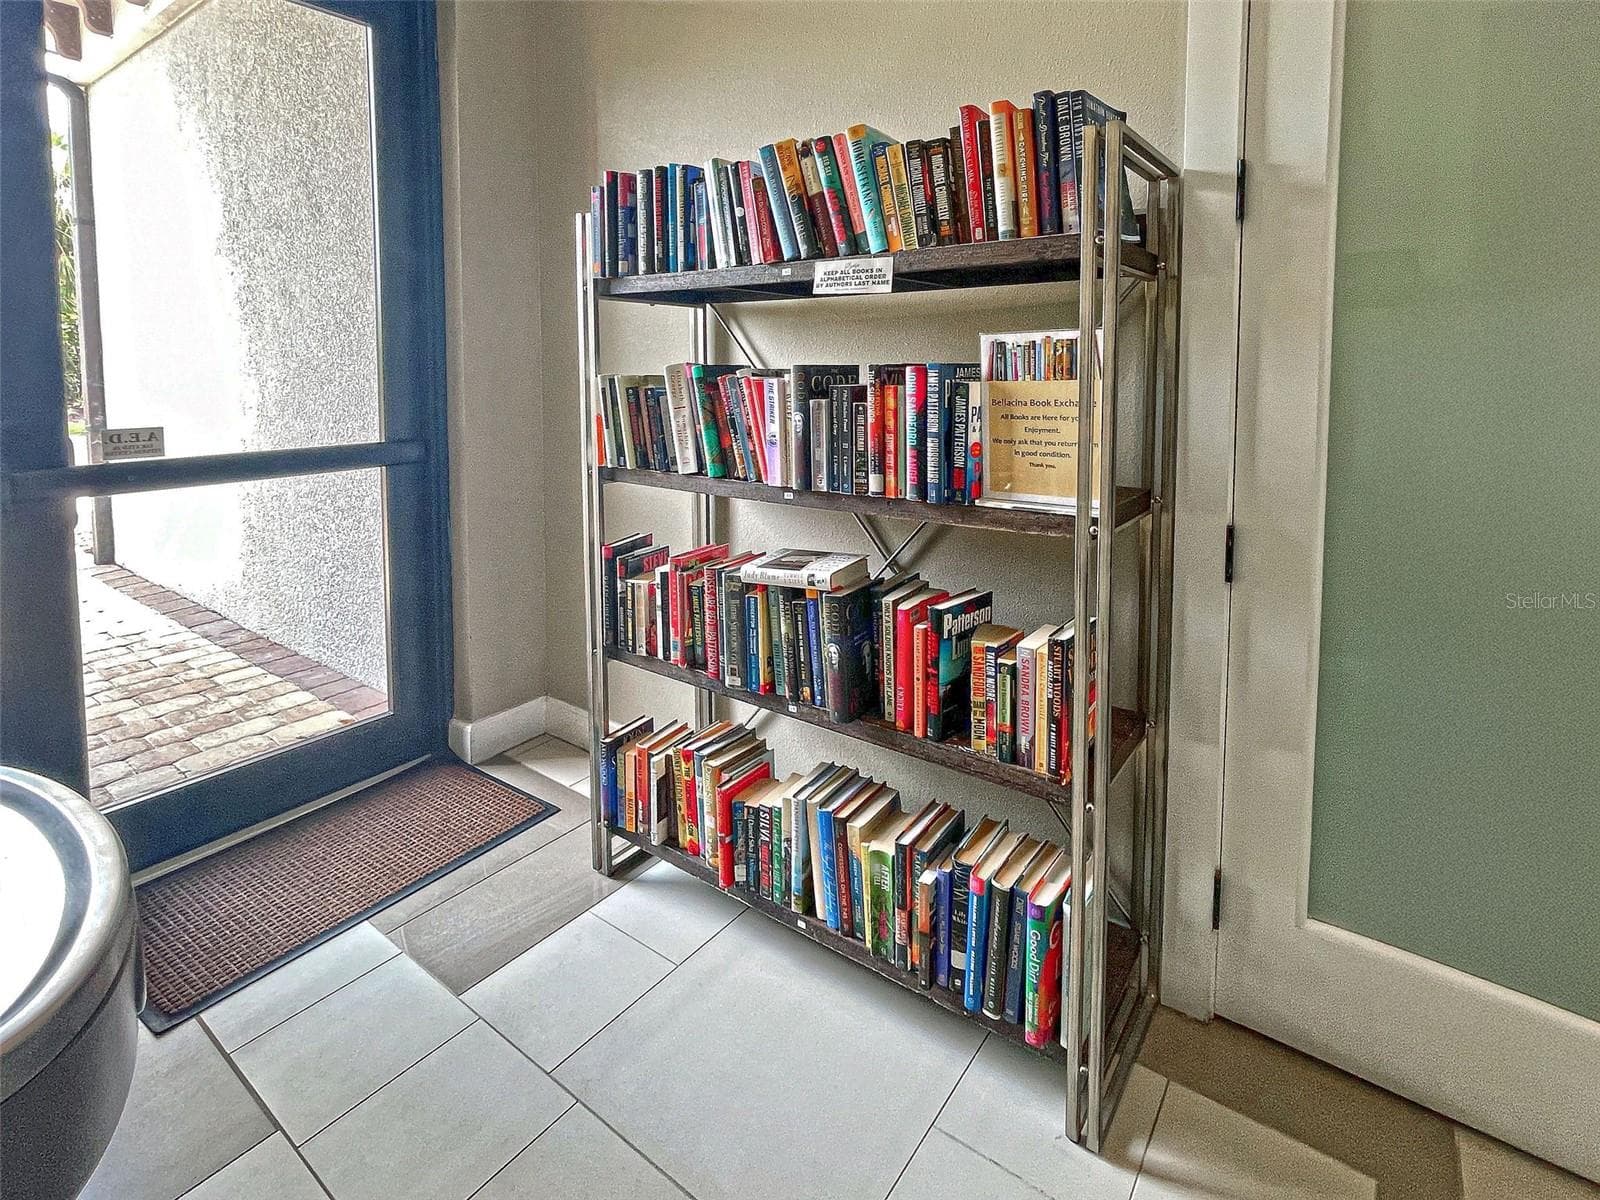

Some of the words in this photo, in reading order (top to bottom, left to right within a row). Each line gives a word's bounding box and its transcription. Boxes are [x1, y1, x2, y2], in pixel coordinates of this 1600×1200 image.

[1056, 96, 1069, 121] DALE
[1071, 96, 1082, 112] TEN
[1058, 124, 1072, 161] BROWN
[850, 139, 874, 205] HOMESEEKING
[875, 154, 889, 183] MICHAEL
[908, 158, 922, 184] MICHAEL
[931, 154, 945, 186] MICHAEL
[966, 158, 975, 184] CLARK
[1018, 141, 1026, 180] CATCHING
[880, 183, 896, 216] CONNELLY
[895, 182, 910, 209] MICHAEL
[912, 184, 926, 214] CONNELLY
[934, 185, 949, 220] CONNELLY
[986, 193, 994, 227] STRANGER
[793, 212, 806, 240] FIRE
[899, 209, 916, 246] CONNELLY
[906, 371, 916, 394] JOHN
[927, 369, 938, 392] JAMES
[955, 366, 982, 379] JAMES
[768, 395, 776, 424] STRIKER
[926, 393, 938, 432] PATTERSON
[954, 395, 965, 423] JAMES
[991, 398, 1028, 408] Bellacina
[1030, 399, 1051, 407] Book
[907, 396, 916, 446] SANDFORD
[1025, 427, 1061, 435] Enjoyment.
[953, 423, 965, 467] PATTERSON
[1022, 450, 1038, 458] good
[926, 437, 938, 484] CROSSHAIRS
[704, 569, 715, 593] ROSES
[705, 594, 716, 609] ARE
[883, 602, 891, 617] ONLY
[693, 613, 702, 646] PATTERSON
[706, 610, 716, 624] RED
[943, 606, 991, 639] Patterson
[706, 630, 719, 673] PATTERSON
[883, 624, 891, 652] SOLDIER
[884, 652, 892, 675] KNOWS
[972, 655, 984, 697] SANDFORD
[986, 650, 995, 676] TAYLOR
[1020, 657, 1029, 695] SANDRA
[1053, 645, 1061, 680] STUART
[986, 677, 995, 701] MOORE
[1052, 681, 1060, 717] WOODS
[973, 717, 985, 740] MOON
[1020, 698, 1029, 734] BROWN
[759, 811, 769, 842] SILVA
[837, 842, 845, 883] CONFESSIONS
[840, 883, 846, 894] ON
[879, 864, 889, 892] AFTER
[952, 862, 968, 904] SUSAN
[1014, 896, 1025, 916] DIRT
[991, 895, 1004, 949] remembrance
[1011, 920, 1022, 944] STUART
[1009, 943, 1019, 970] WOODS
[1029, 929, 1040, 961] Good
[1029, 961, 1040, 984] Dirt
